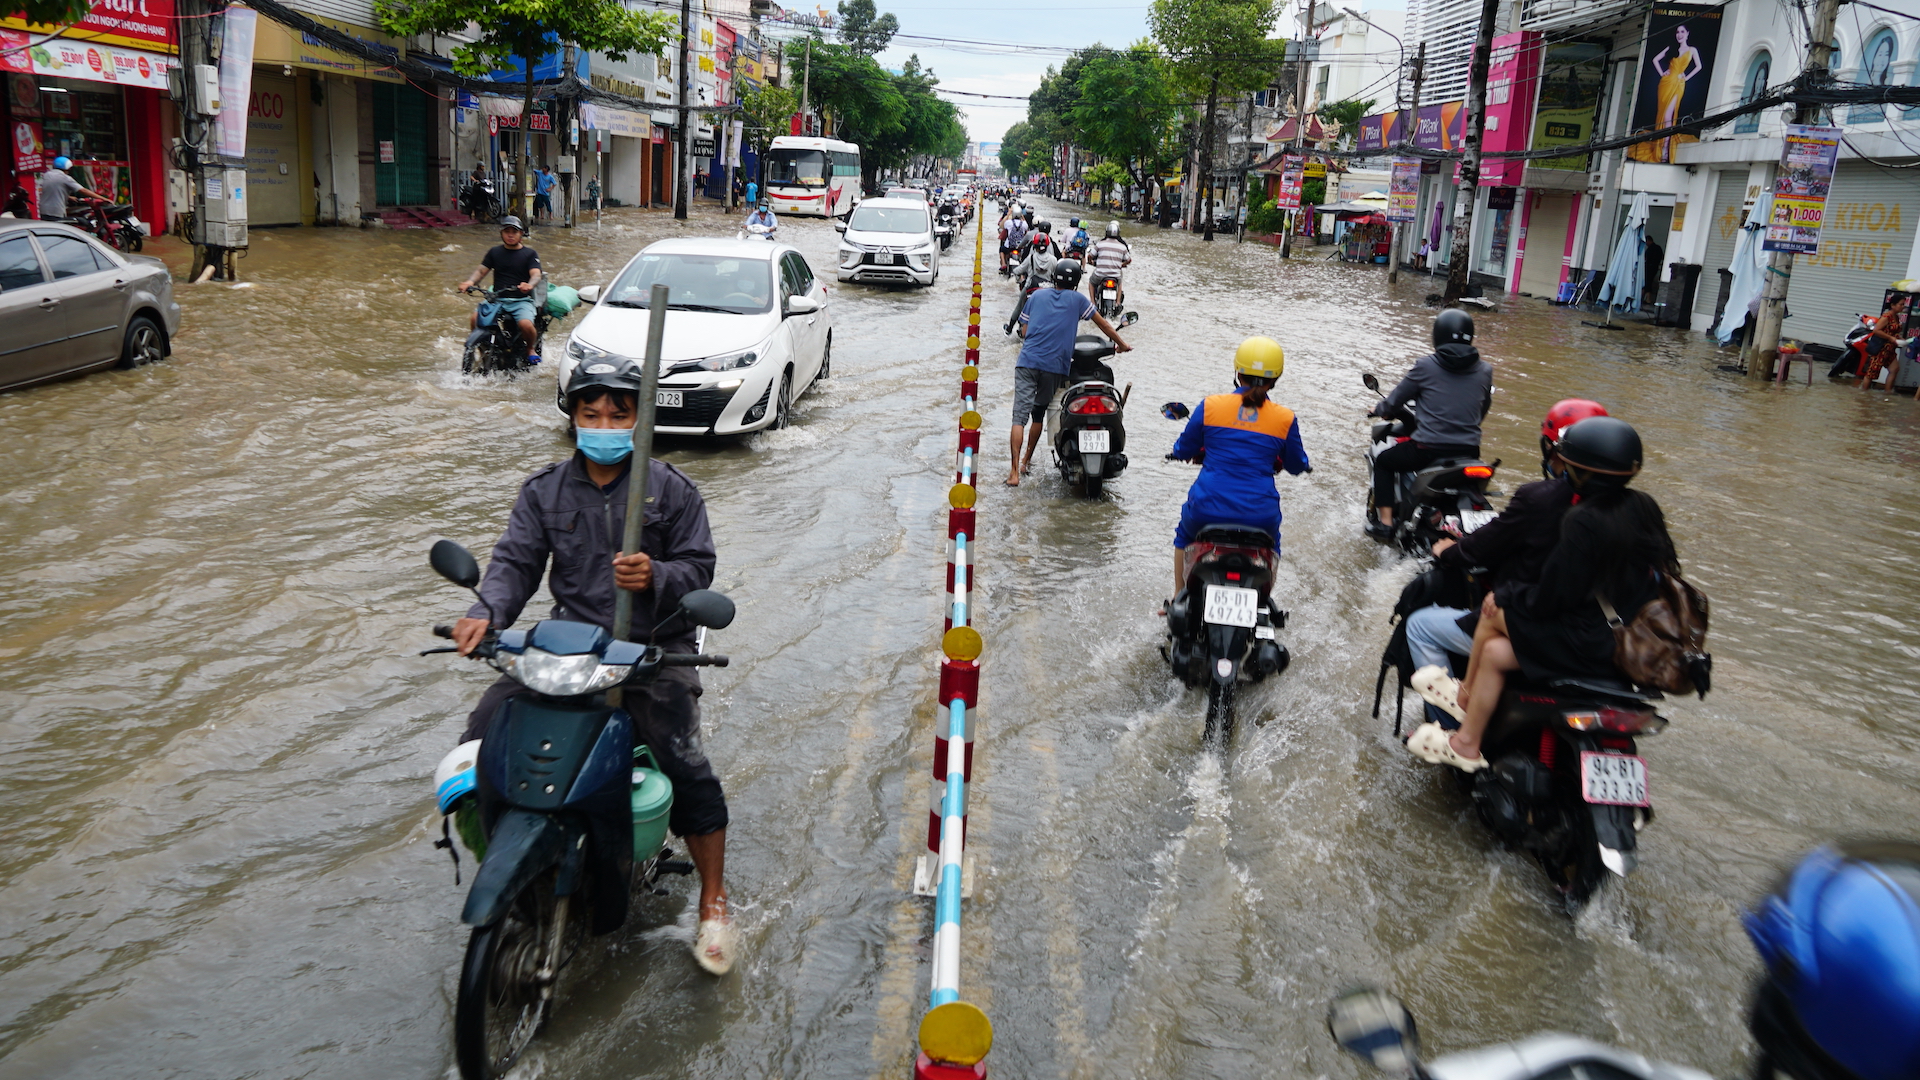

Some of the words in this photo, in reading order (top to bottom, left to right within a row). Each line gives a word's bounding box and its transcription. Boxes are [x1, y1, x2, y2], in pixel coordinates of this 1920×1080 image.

[1668, 9, 1687, 17] KHOA
[530, 110, 551, 130] HÀ
[1419, 117, 1440, 135] TPBank
[1548, 126, 1566, 137] 833
[1793, 207, 1822, 222] 1.000
[1833, 202, 1902, 232] KHOA
[1083, 441, 1105, 451] 2979
